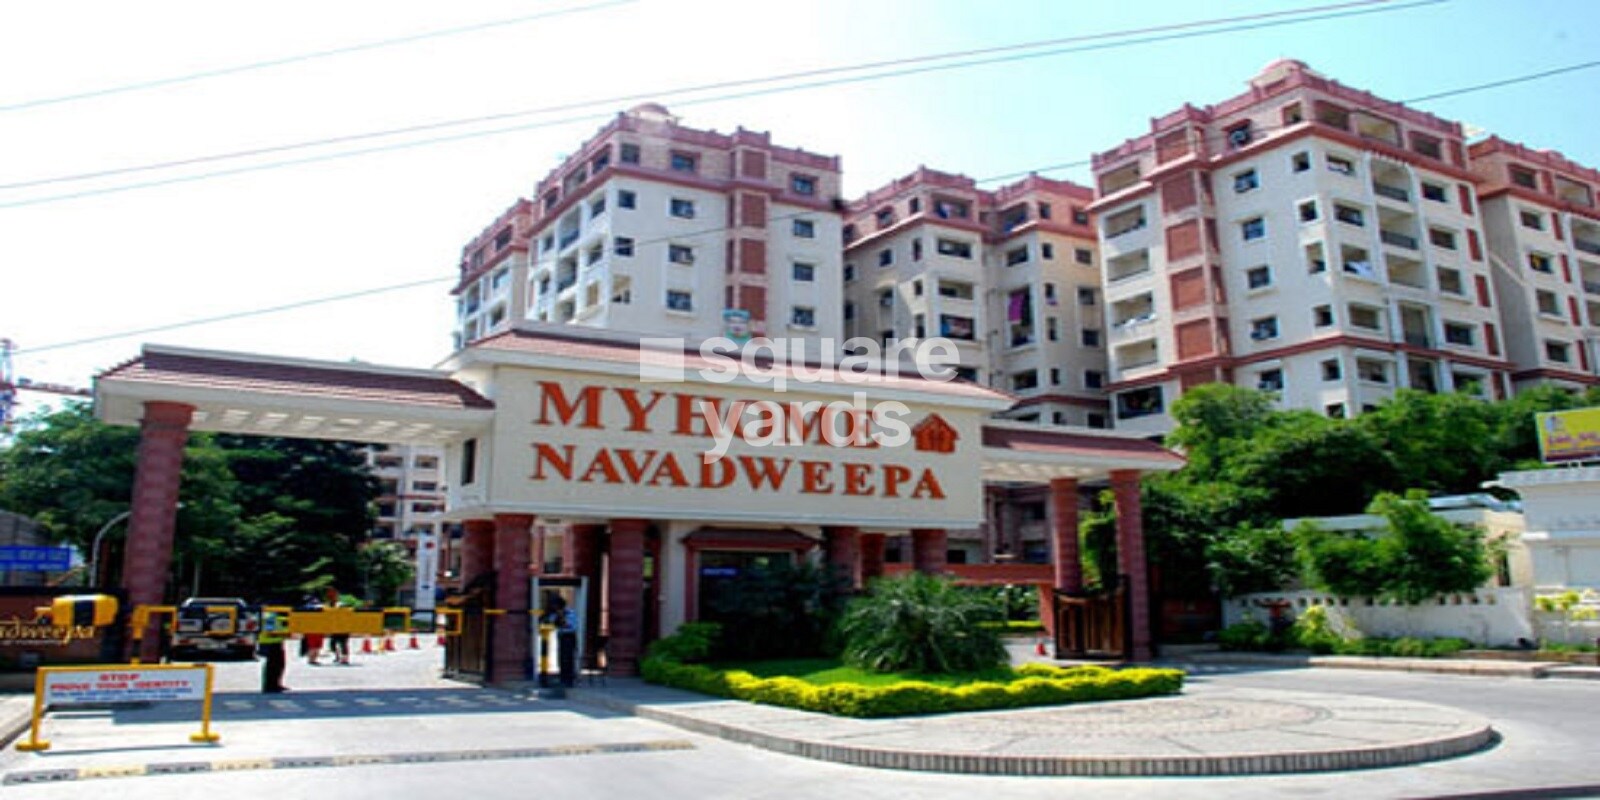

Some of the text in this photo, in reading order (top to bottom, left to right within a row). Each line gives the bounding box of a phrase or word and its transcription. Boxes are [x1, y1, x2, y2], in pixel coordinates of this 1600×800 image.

[530, 442, 945, 500] NAVADWEEPA
[99, 673, 141, 681] STOP
[96, 681, 129, 690] YOUR
[134, 680, 189, 688] IDENTITY
